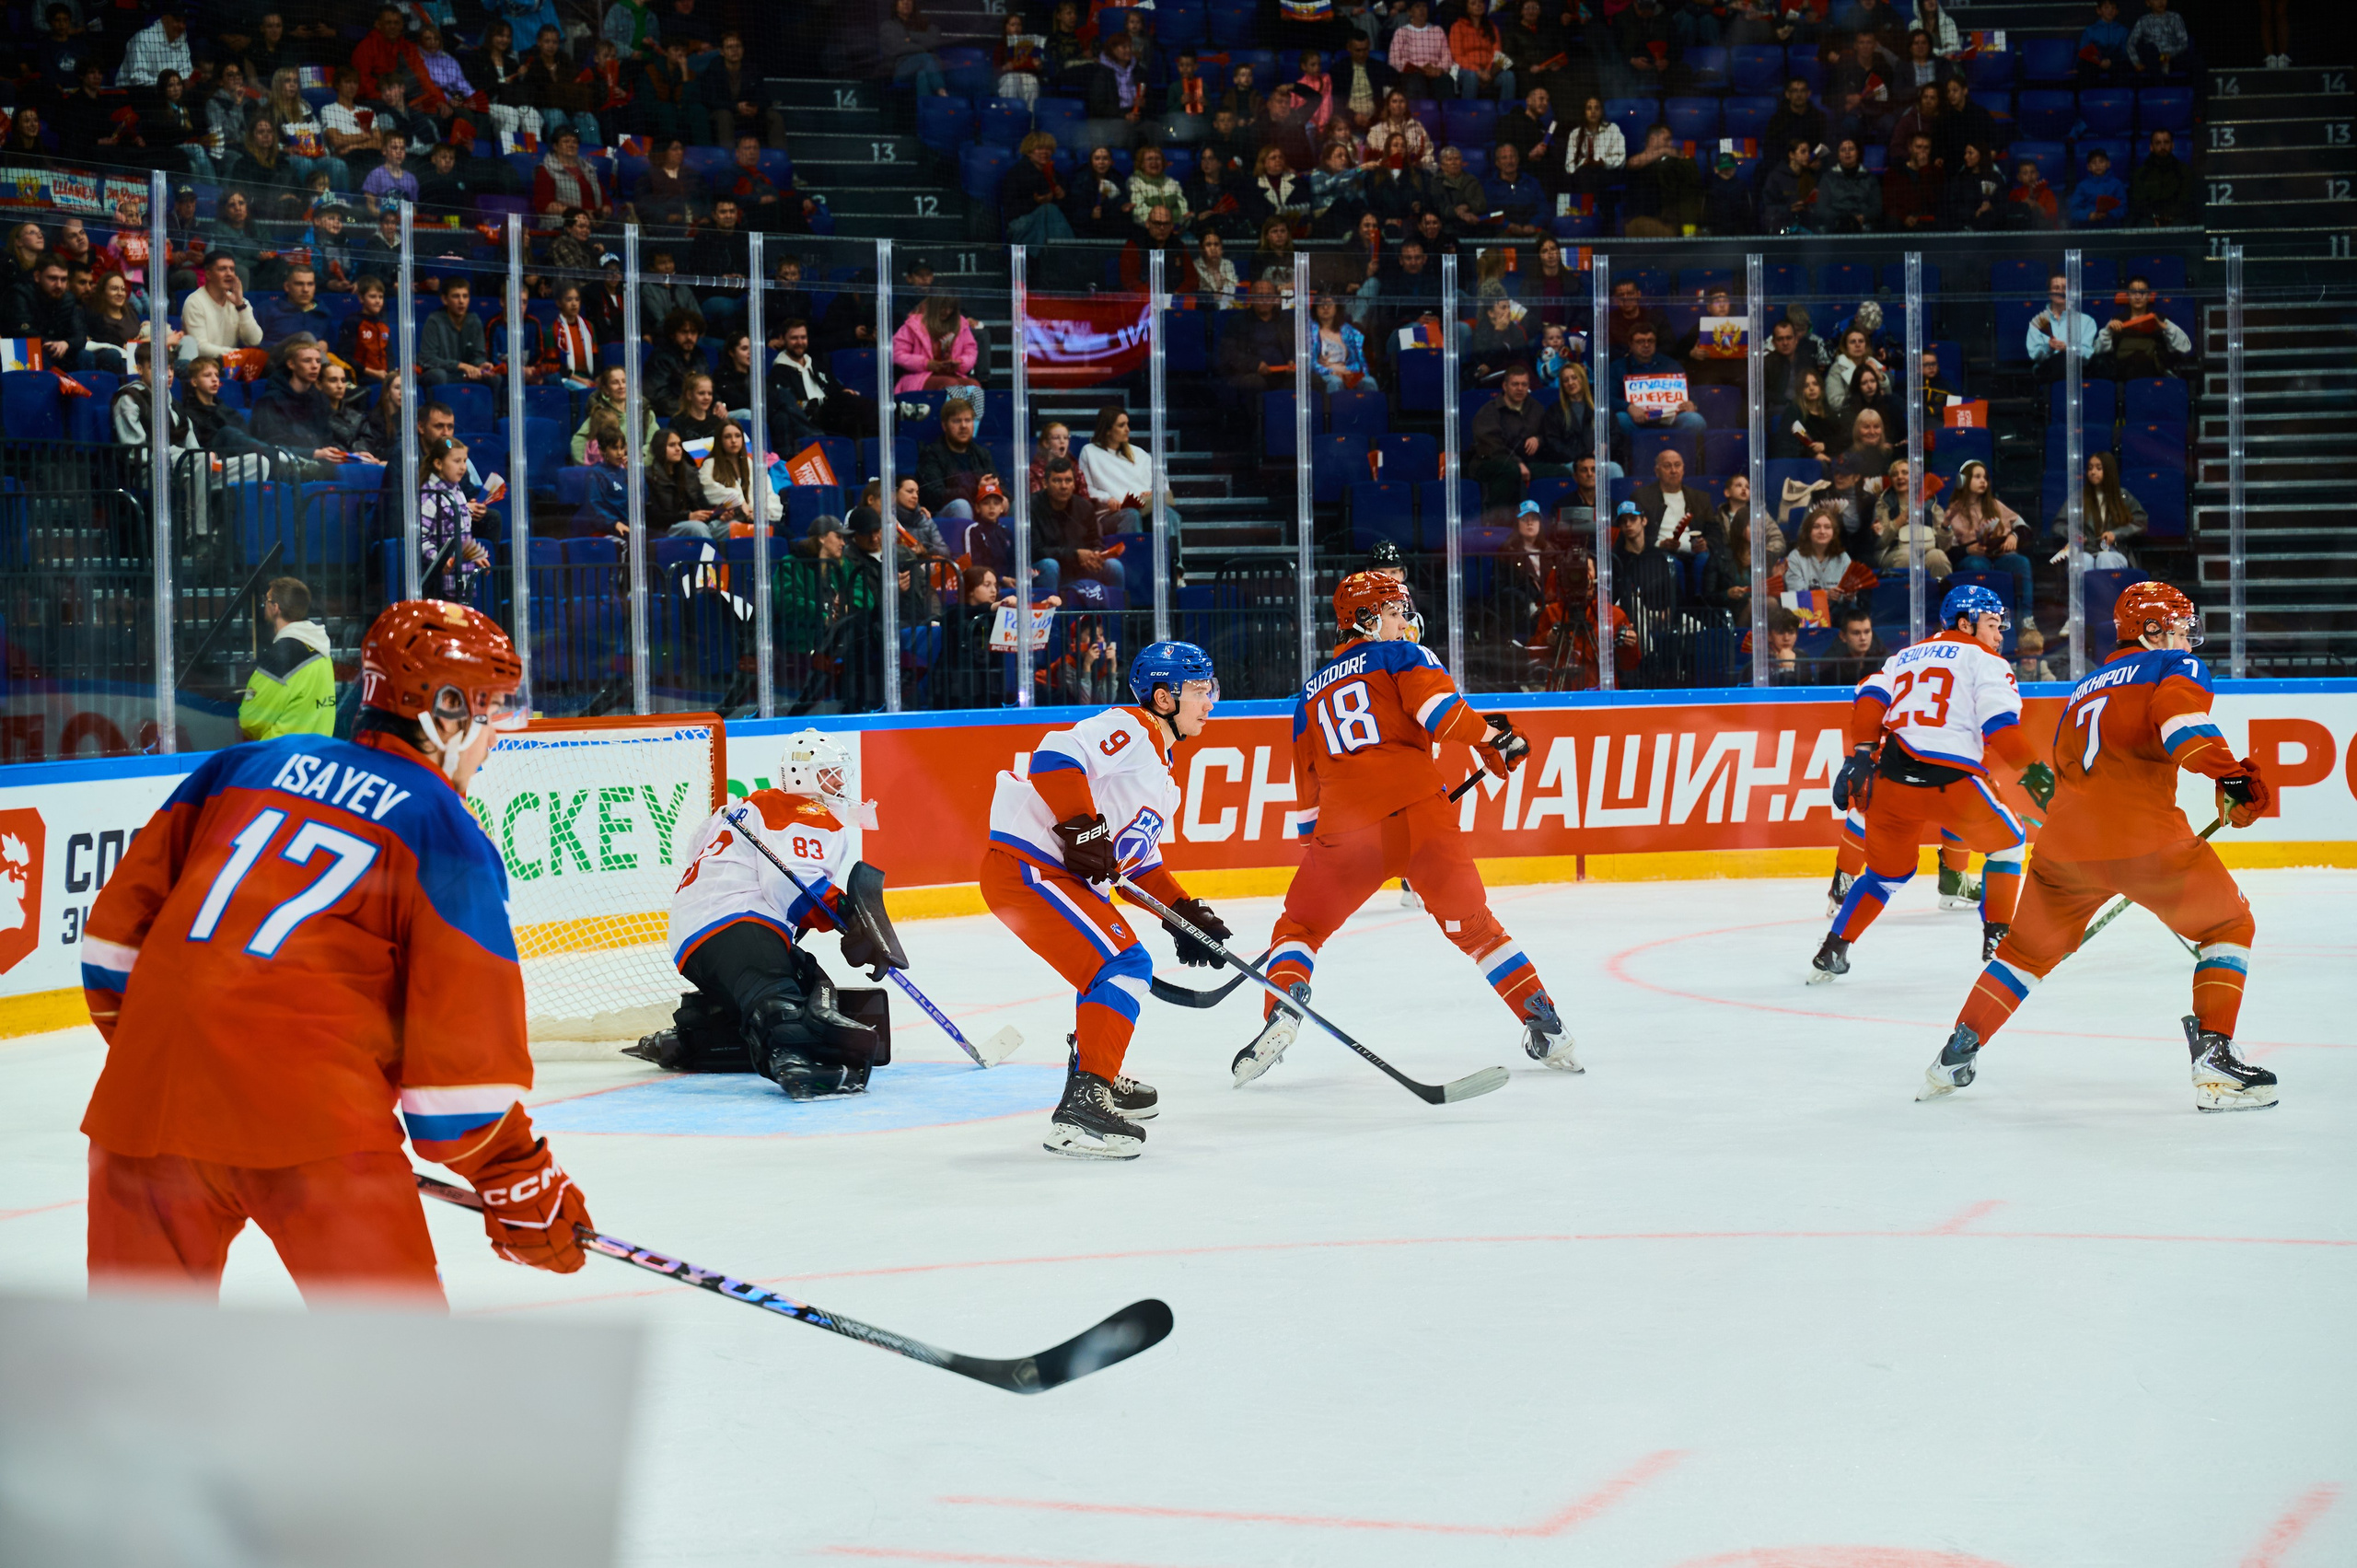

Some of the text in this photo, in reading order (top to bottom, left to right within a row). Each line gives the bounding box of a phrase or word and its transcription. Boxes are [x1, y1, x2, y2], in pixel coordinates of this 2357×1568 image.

[2215, 76, 2240, 97] 14
[2322, 73, 2346, 93] 14
[833, 89, 857, 110] 14
[2210, 127, 2235, 147] 13
[2325, 123, 2351, 144] 13
[871, 143, 896, 163] 13
[2209, 183, 2234, 204] 12
[2326, 180, 2351, 200] 12
[913, 195, 939, 217] 12
[2329, 234, 2350, 258] 11
[957, 252, 977, 273] 11
[1897, 645, 1959, 667] ВЕЩУНОВ
[1306, 653, 1367, 701] SUZDORF
[2182, 658, 2199, 678] 7
[2005, 672, 2019, 693] 2
[1884, 667, 1955, 729] 23
[1317, 680, 1381, 755] 18
[1099, 729, 1131, 756] 9
[2076, 695, 2109, 772] 7
[1459, 728, 1848, 832] МАШИНА
[2248, 718, 2357, 819] Р
[272, 753, 412, 820] ISAYEV
[793, 836, 824, 860] 83
[64, 828, 145, 894] СП
[186, 806, 383, 960] 17
[483, 1163, 563, 1205] CCM
